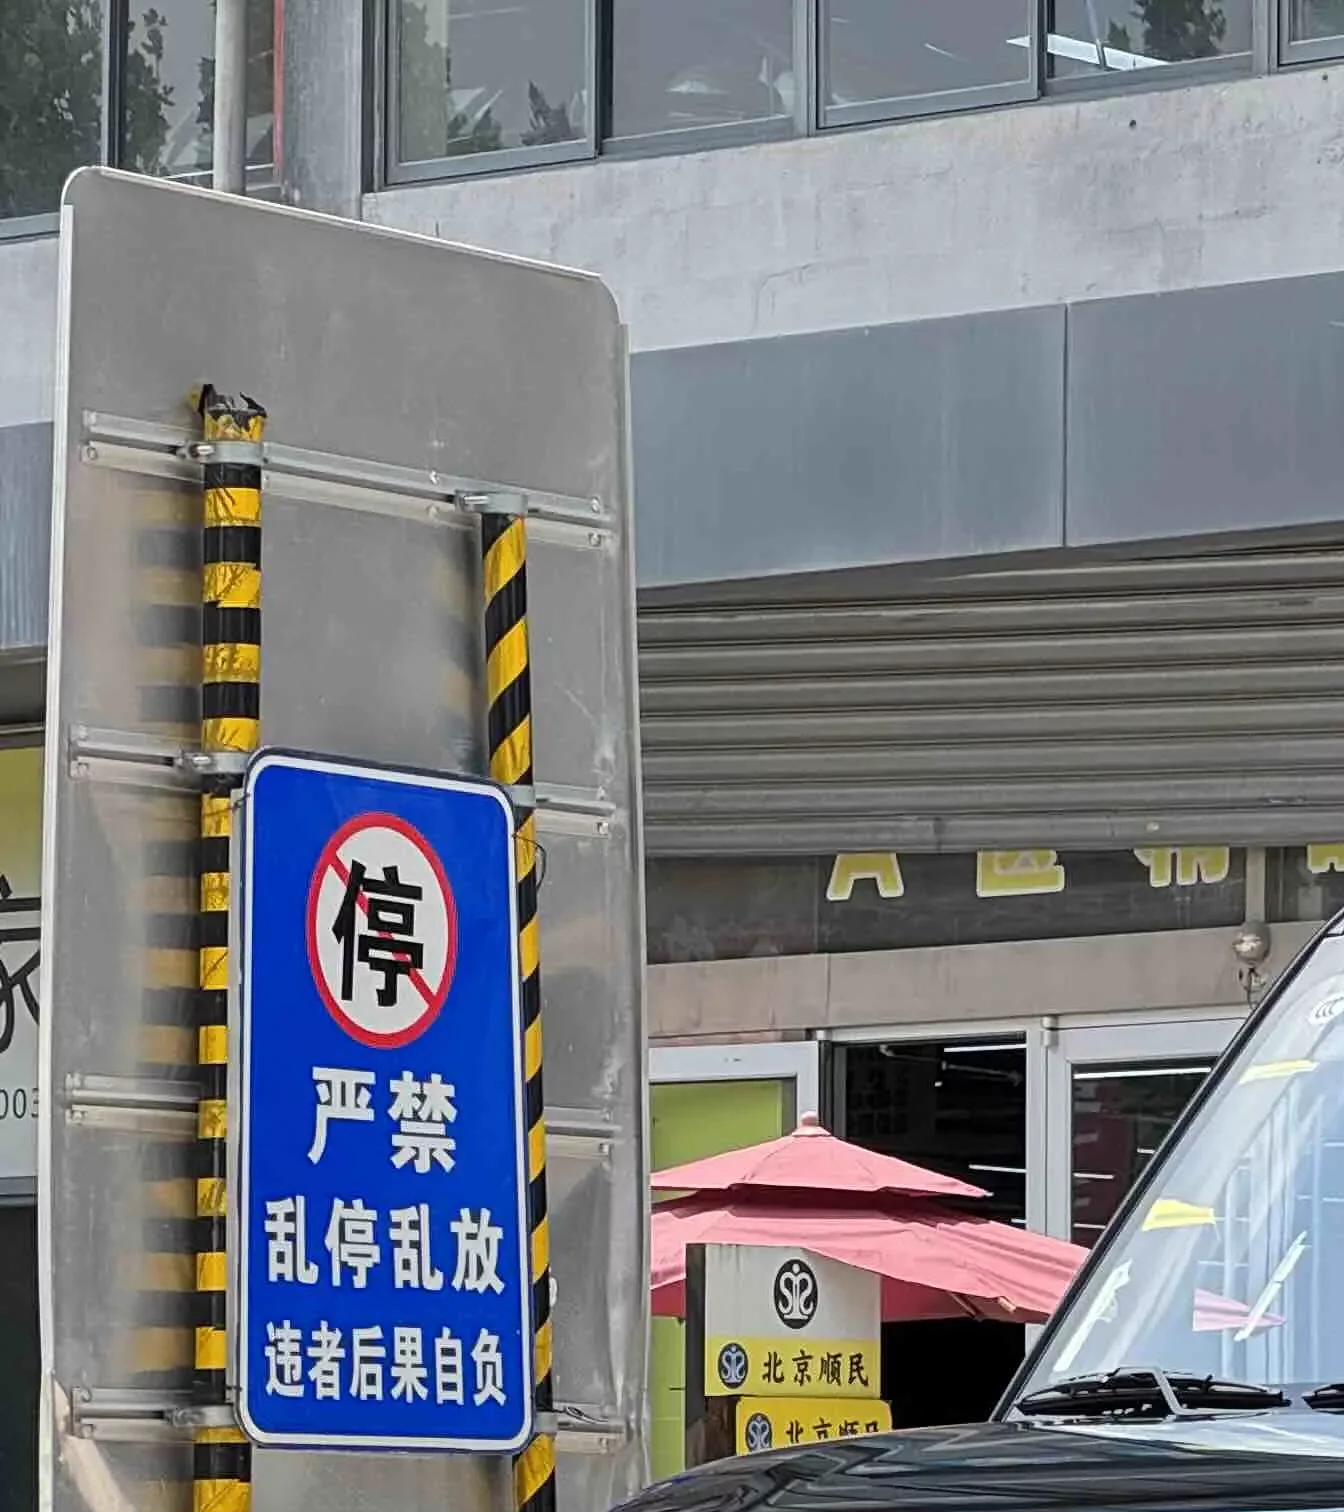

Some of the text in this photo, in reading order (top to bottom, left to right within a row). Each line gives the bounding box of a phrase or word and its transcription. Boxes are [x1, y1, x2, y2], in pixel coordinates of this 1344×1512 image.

[331, 858, 425, 1008] 停
[307, 1066, 457, 1175] 严禁
[264, 1195, 504, 1295] 乱停乱放
[264, 1320, 506, 1406] 违者后果自负
[762, 1349, 869, 1386] 北京顺民
